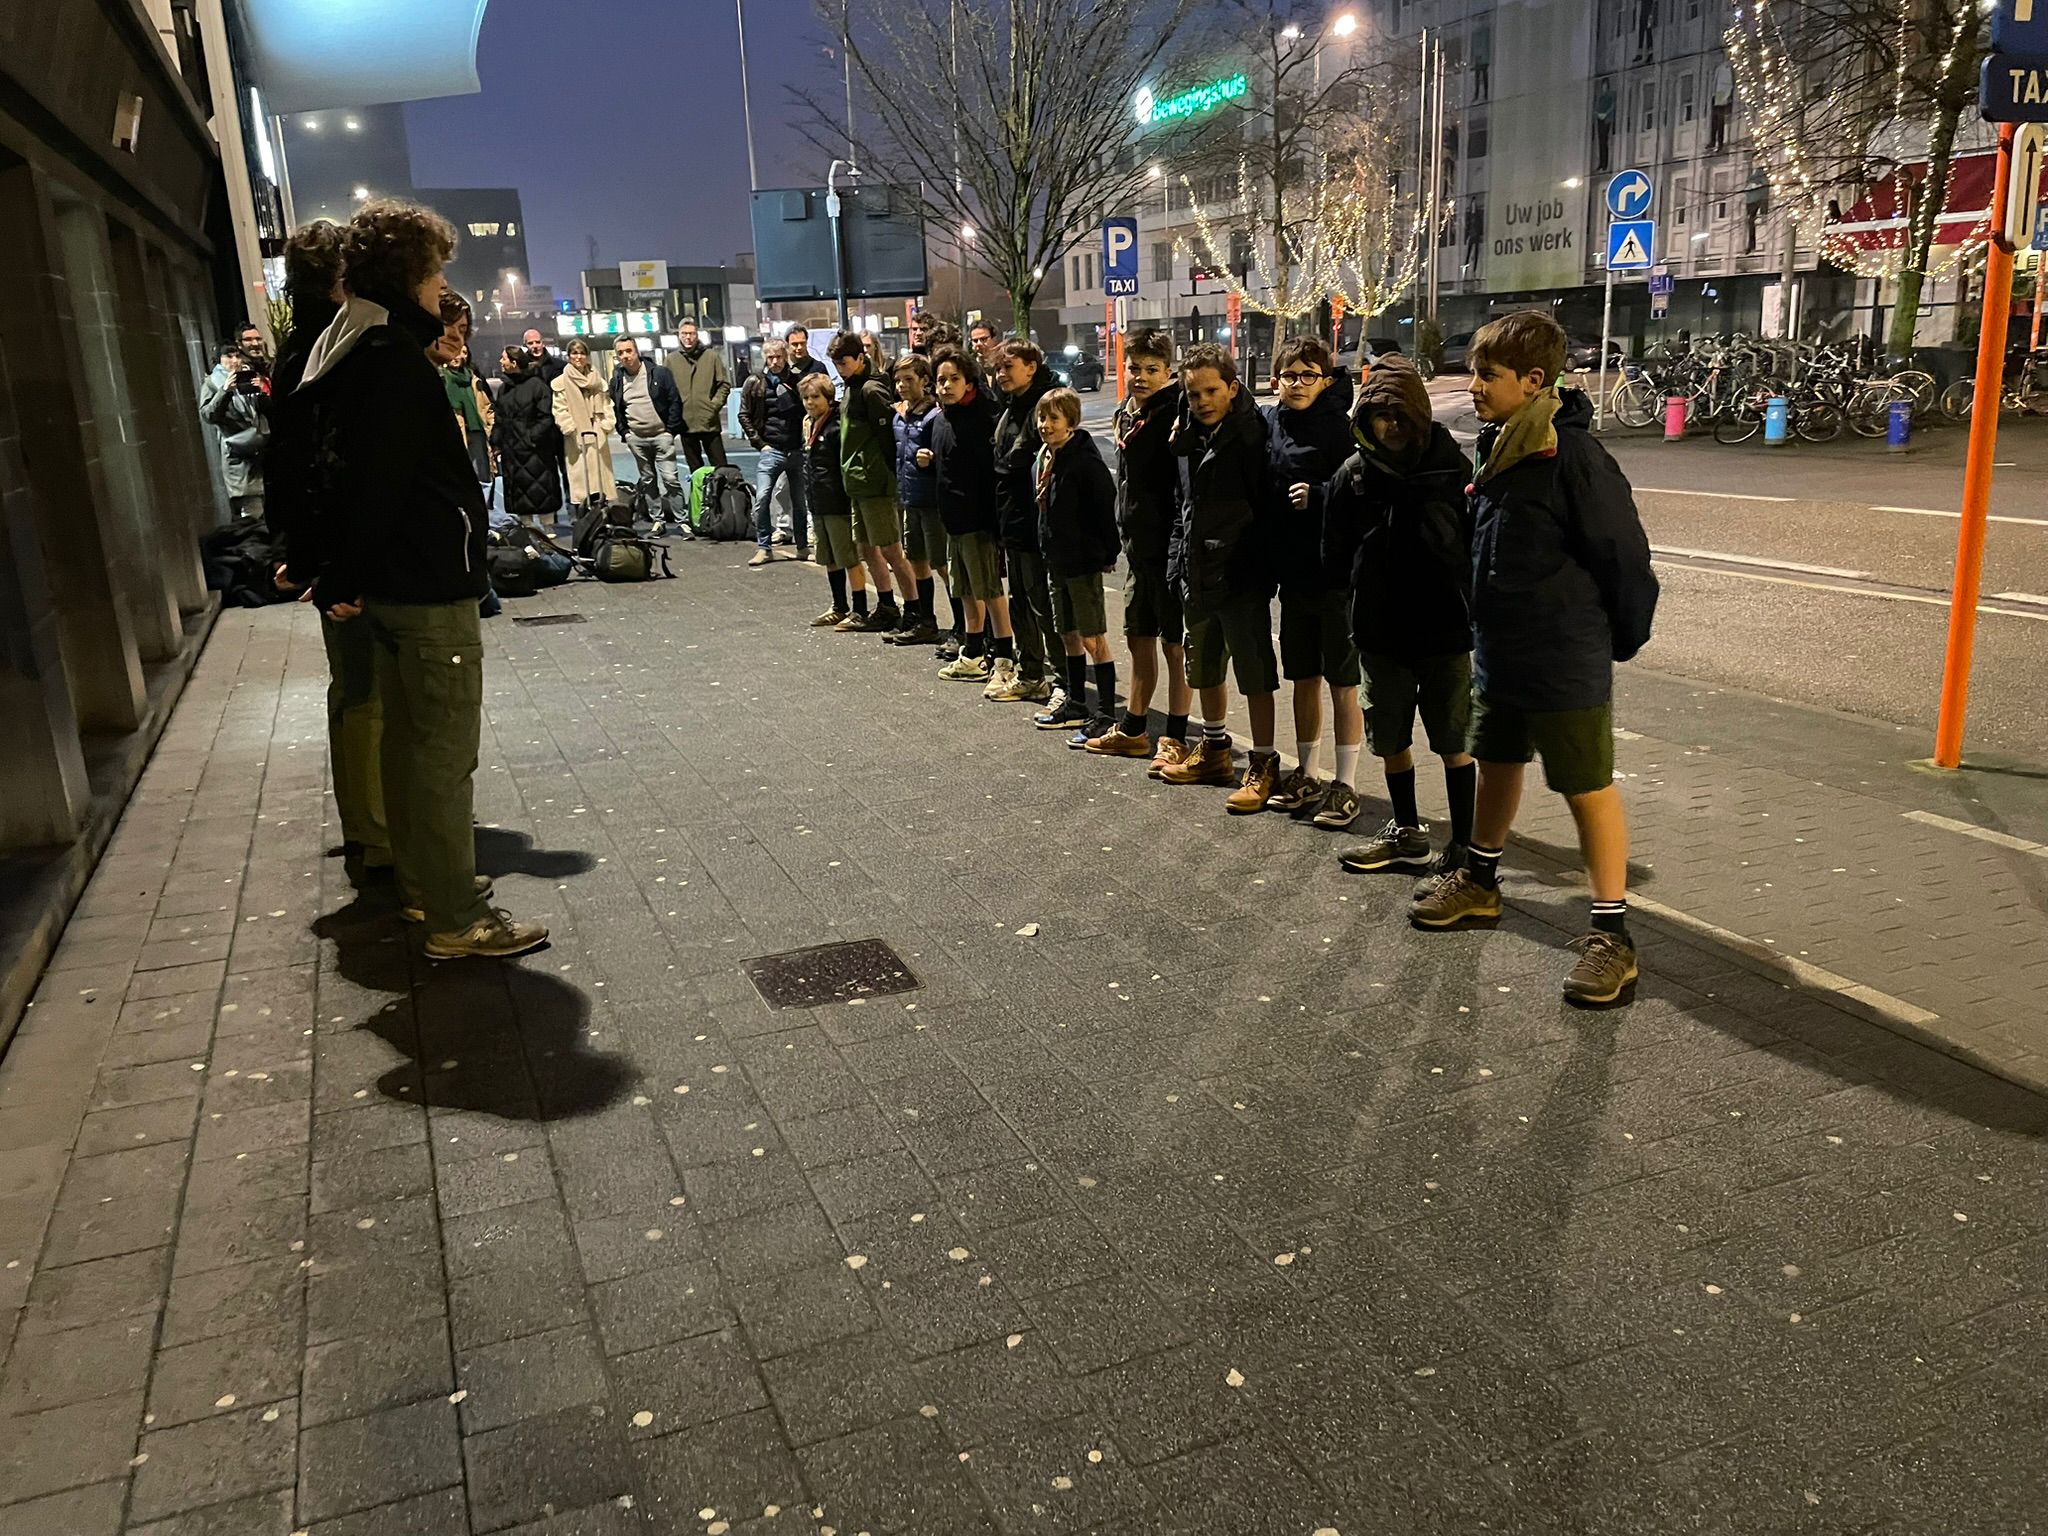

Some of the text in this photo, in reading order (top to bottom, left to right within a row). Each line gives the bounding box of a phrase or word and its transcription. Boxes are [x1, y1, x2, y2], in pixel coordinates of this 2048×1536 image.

[2009, 69, 2048, 104] TA
[1505, 197, 1564, 227] Uw job
[1108, 226, 1133, 267] P
[1494, 228, 1573, 256] ons werk
[1109, 279, 1135, 293] TAXI
